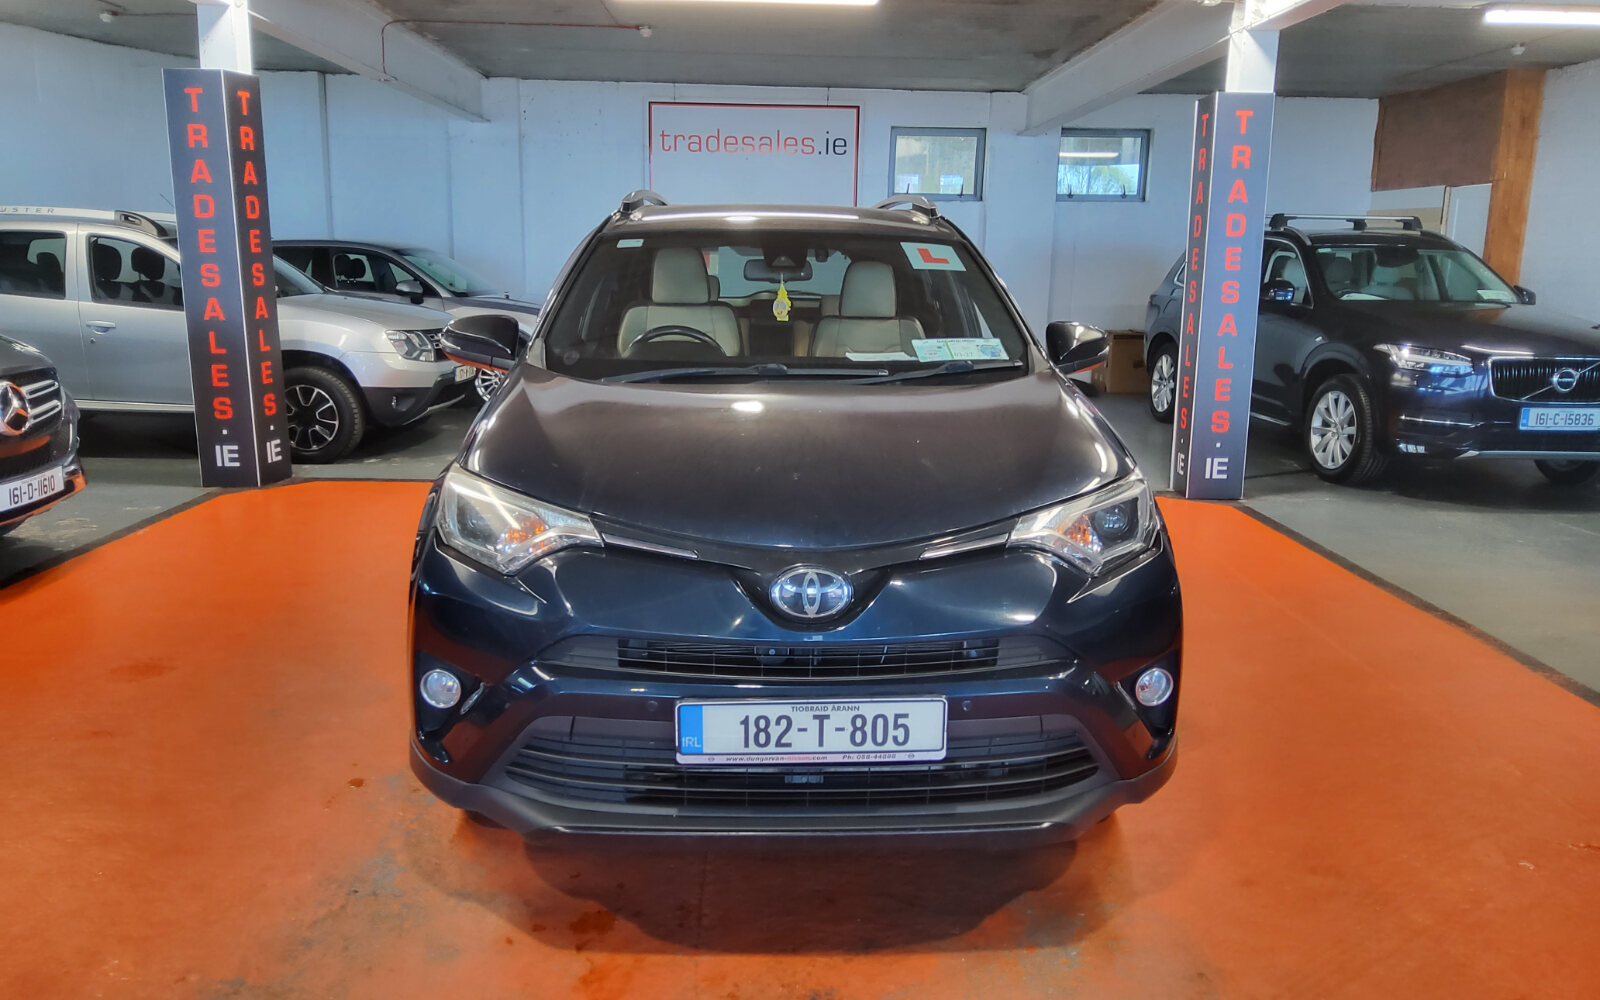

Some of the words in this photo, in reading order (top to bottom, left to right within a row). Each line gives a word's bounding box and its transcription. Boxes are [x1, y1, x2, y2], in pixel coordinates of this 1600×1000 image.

[660, 128, 847, 156] tradesales.ie
[916, 247, 950, 265] L
[1535, 412, 1595, 426] 161-C-15836
[8, 474, 56, 506] 161-D-11610
[791, 705, 829, 713] TIOBRAID
[739, 713, 910, 749] 182-T-805
[682, 736, 702, 748] IRL
